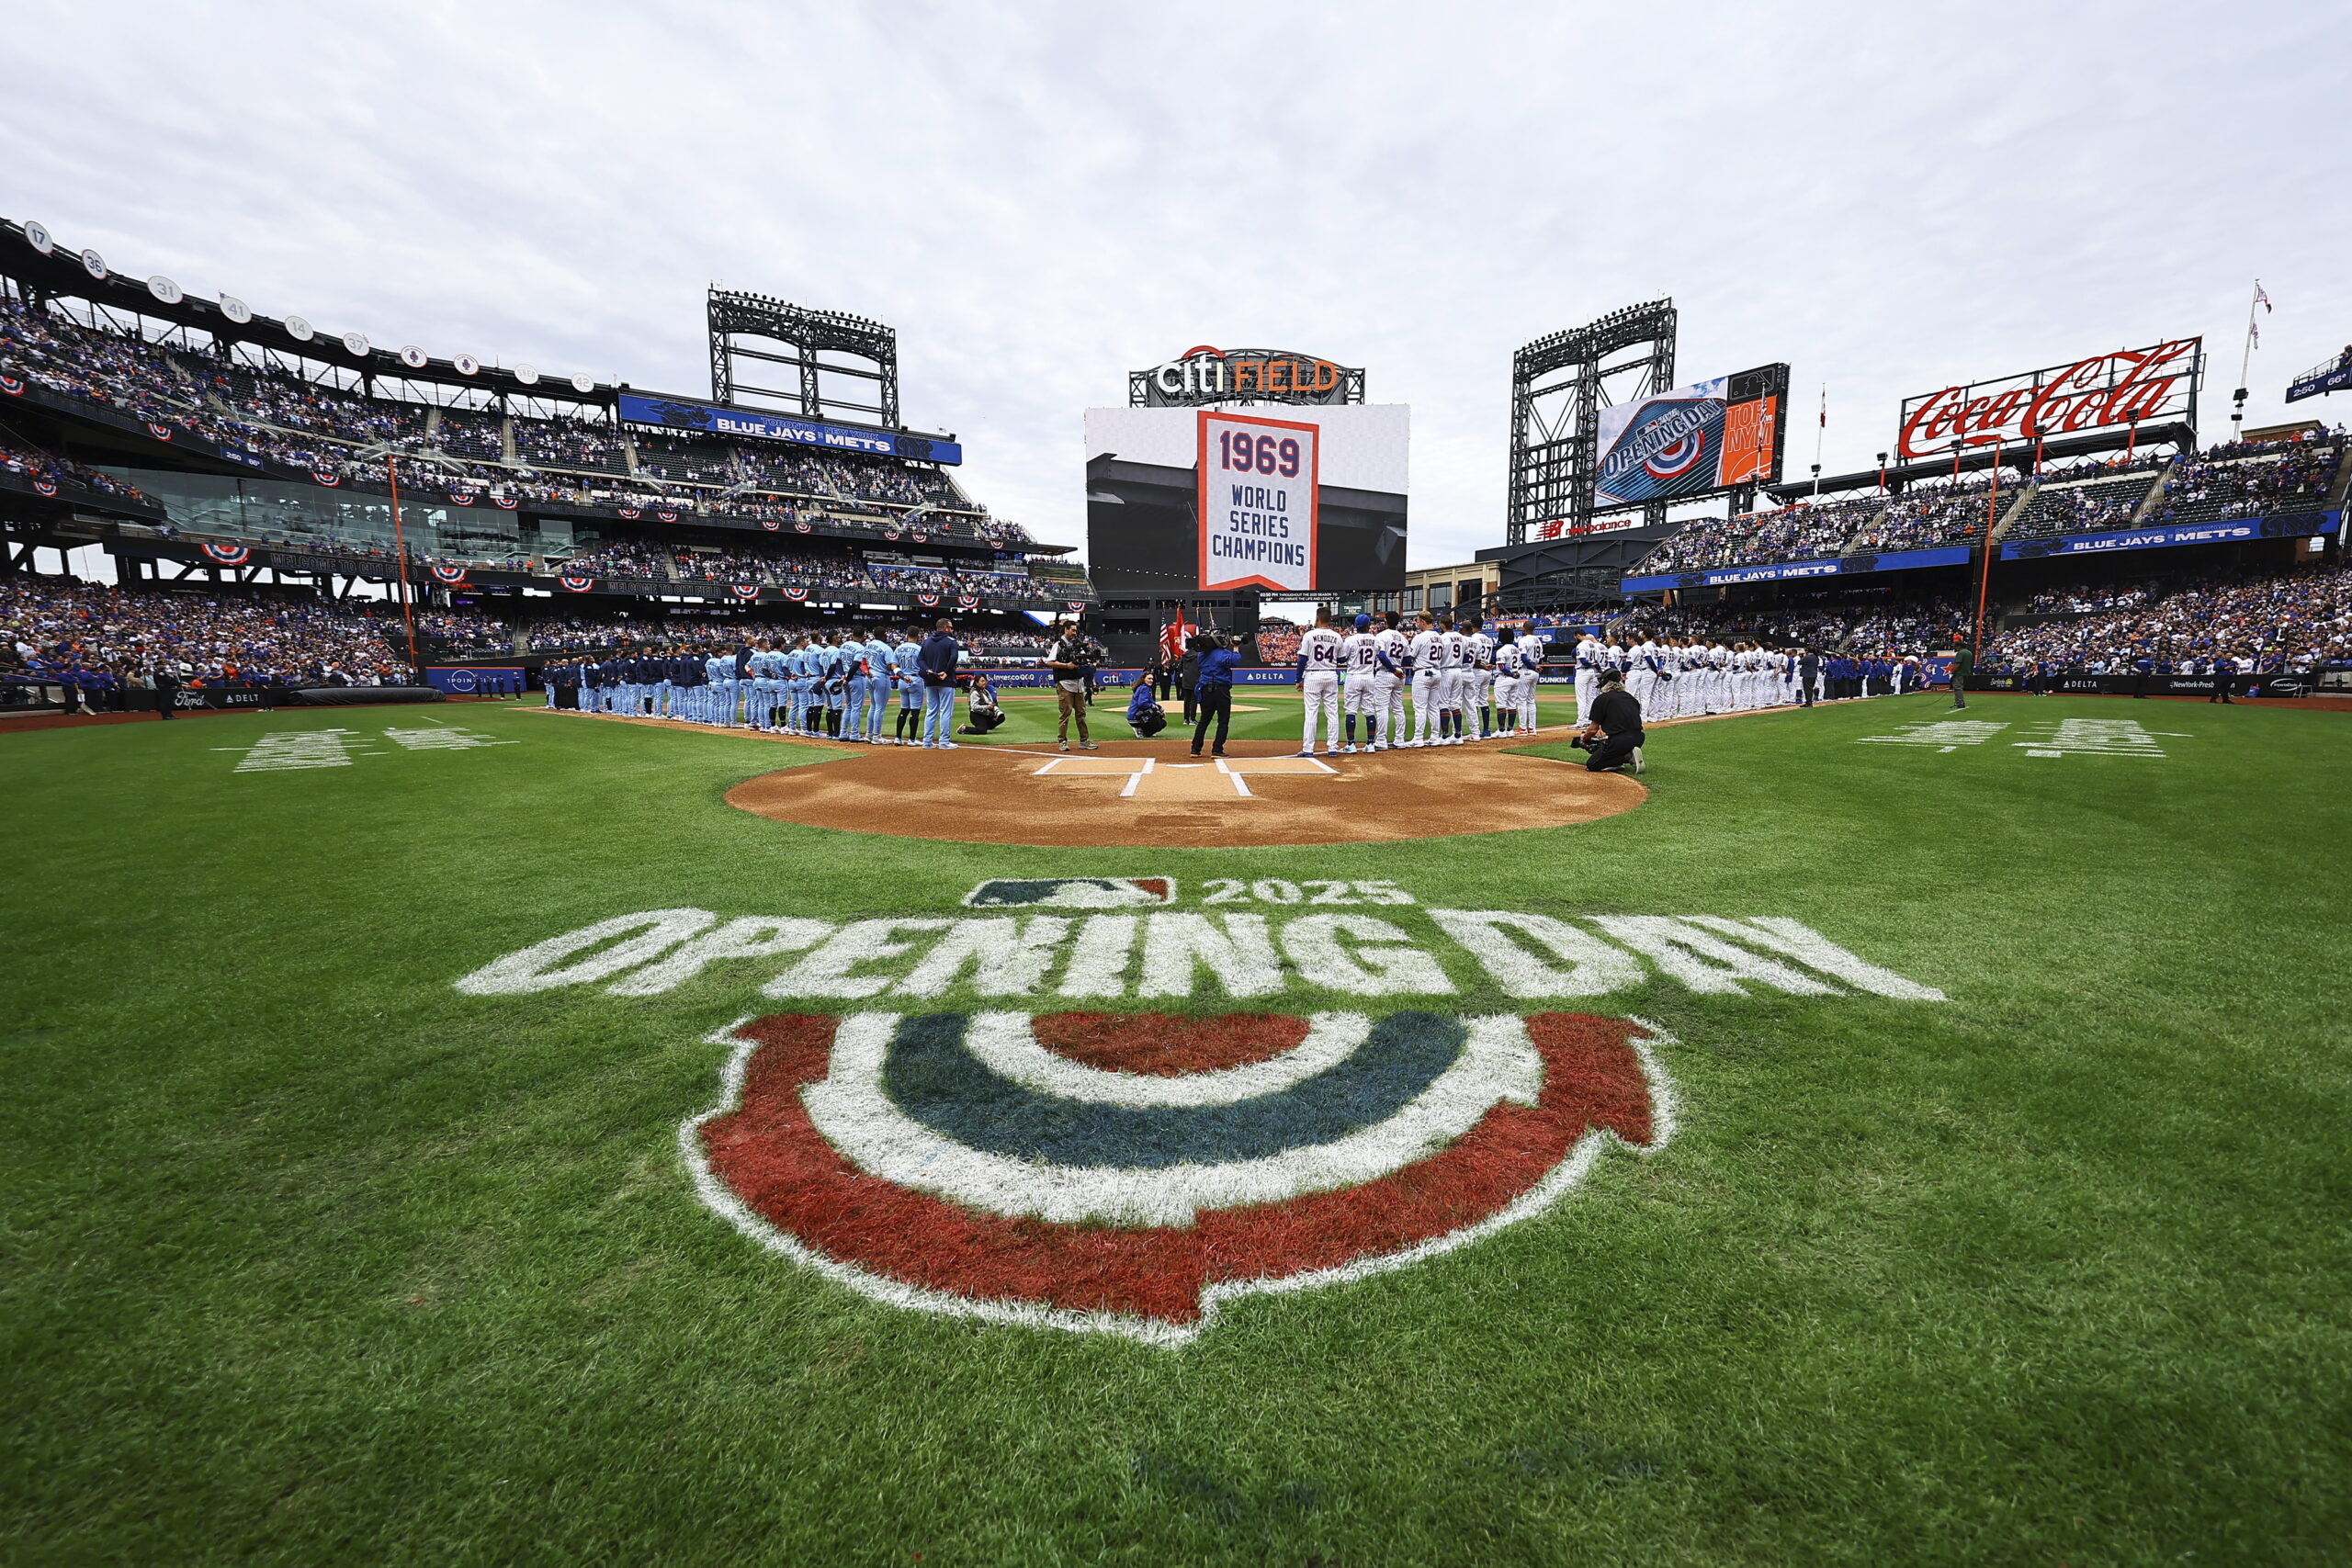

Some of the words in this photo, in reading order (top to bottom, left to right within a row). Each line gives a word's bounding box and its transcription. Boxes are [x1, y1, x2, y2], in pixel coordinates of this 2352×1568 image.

[32, 229, 45, 245] 17
[87, 256, 102, 273] 36
[157, 282, 174, 299] 31
[229, 302, 244, 317] 41
[292, 321, 306, 335] 14
[349, 337, 364, 351] 37
[1157, 353, 1224, 393] citi
[1235, 360, 1338, 393] FIELD
[575, 378, 590, 388] 42
[1898, 335, 2202, 458] Coca-Cola
[2293, 384, 2315, 398] 2:50
[1726, 400, 1767, 429] TOR
[717, 418, 766, 435] BLUE
[769, 427, 817, 443] JAYS
[761, 416, 817, 432] TORONTO
[825, 426, 848, 436] NEW
[850, 429, 879, 441] YORK
[1603, 418, 1688, 479] OPENING
[1686, 398, 1723, 430] DAY
[1726, 422, 1774, 453] NYM
[825, 434, 891, 452] METS
[1219, 429, 1300, 479] 1969
[1231, 483, 1286, 513] WORLD
[1229, 510, 1289, 539] SERIES
[1587, 519, 1632, 533] balance
[2175, 527, 2251, 542] METS
[2073, 539, 2117, 550] BLUE
[2120, 535, 2165, 547] JAYS
[1212, 534, 1305, 567] CHAMPIONS
[270, 552, 337, 572] WELCOME
[339, 558, 357, 573] TO
[1710, 574, 1741, 584] BLUE
[1743, 570, 1776, 581] JAYS
[1782, 565, 1838, 577] METS
[660, 583, 673, 595] TO
[1312, 635, 1338, 645] MENDOZA
[1357, 638, 1375, 647] LINDOR
[840, 651, 854, 666] 25
[1314, 644, 1335, 662] 64
[1359, 648, 1374, 665] 12
[1389, 642, 1404, 660] 22
[1430, 645, 1443, 661] 20
[1453, 644, 1461, 659] 9
[1481, 645, 1492, 660] 27
[1532, 645, 1541, 659] 19
[899, 655, 912, 670] 11
[1511, 655, 1518, 670] 2
[1102, 673, 1119, 683] citi
[2071, 680, 2098, 688] DELTA
[175, 691, 205, 706] Ford
[236, 694, 258, 702] DELT
[1202, 878, 1416, 906] 2025
[449, 908, 1459, 999] OPENING
[1427, 908, 1952, 1003] DAY
